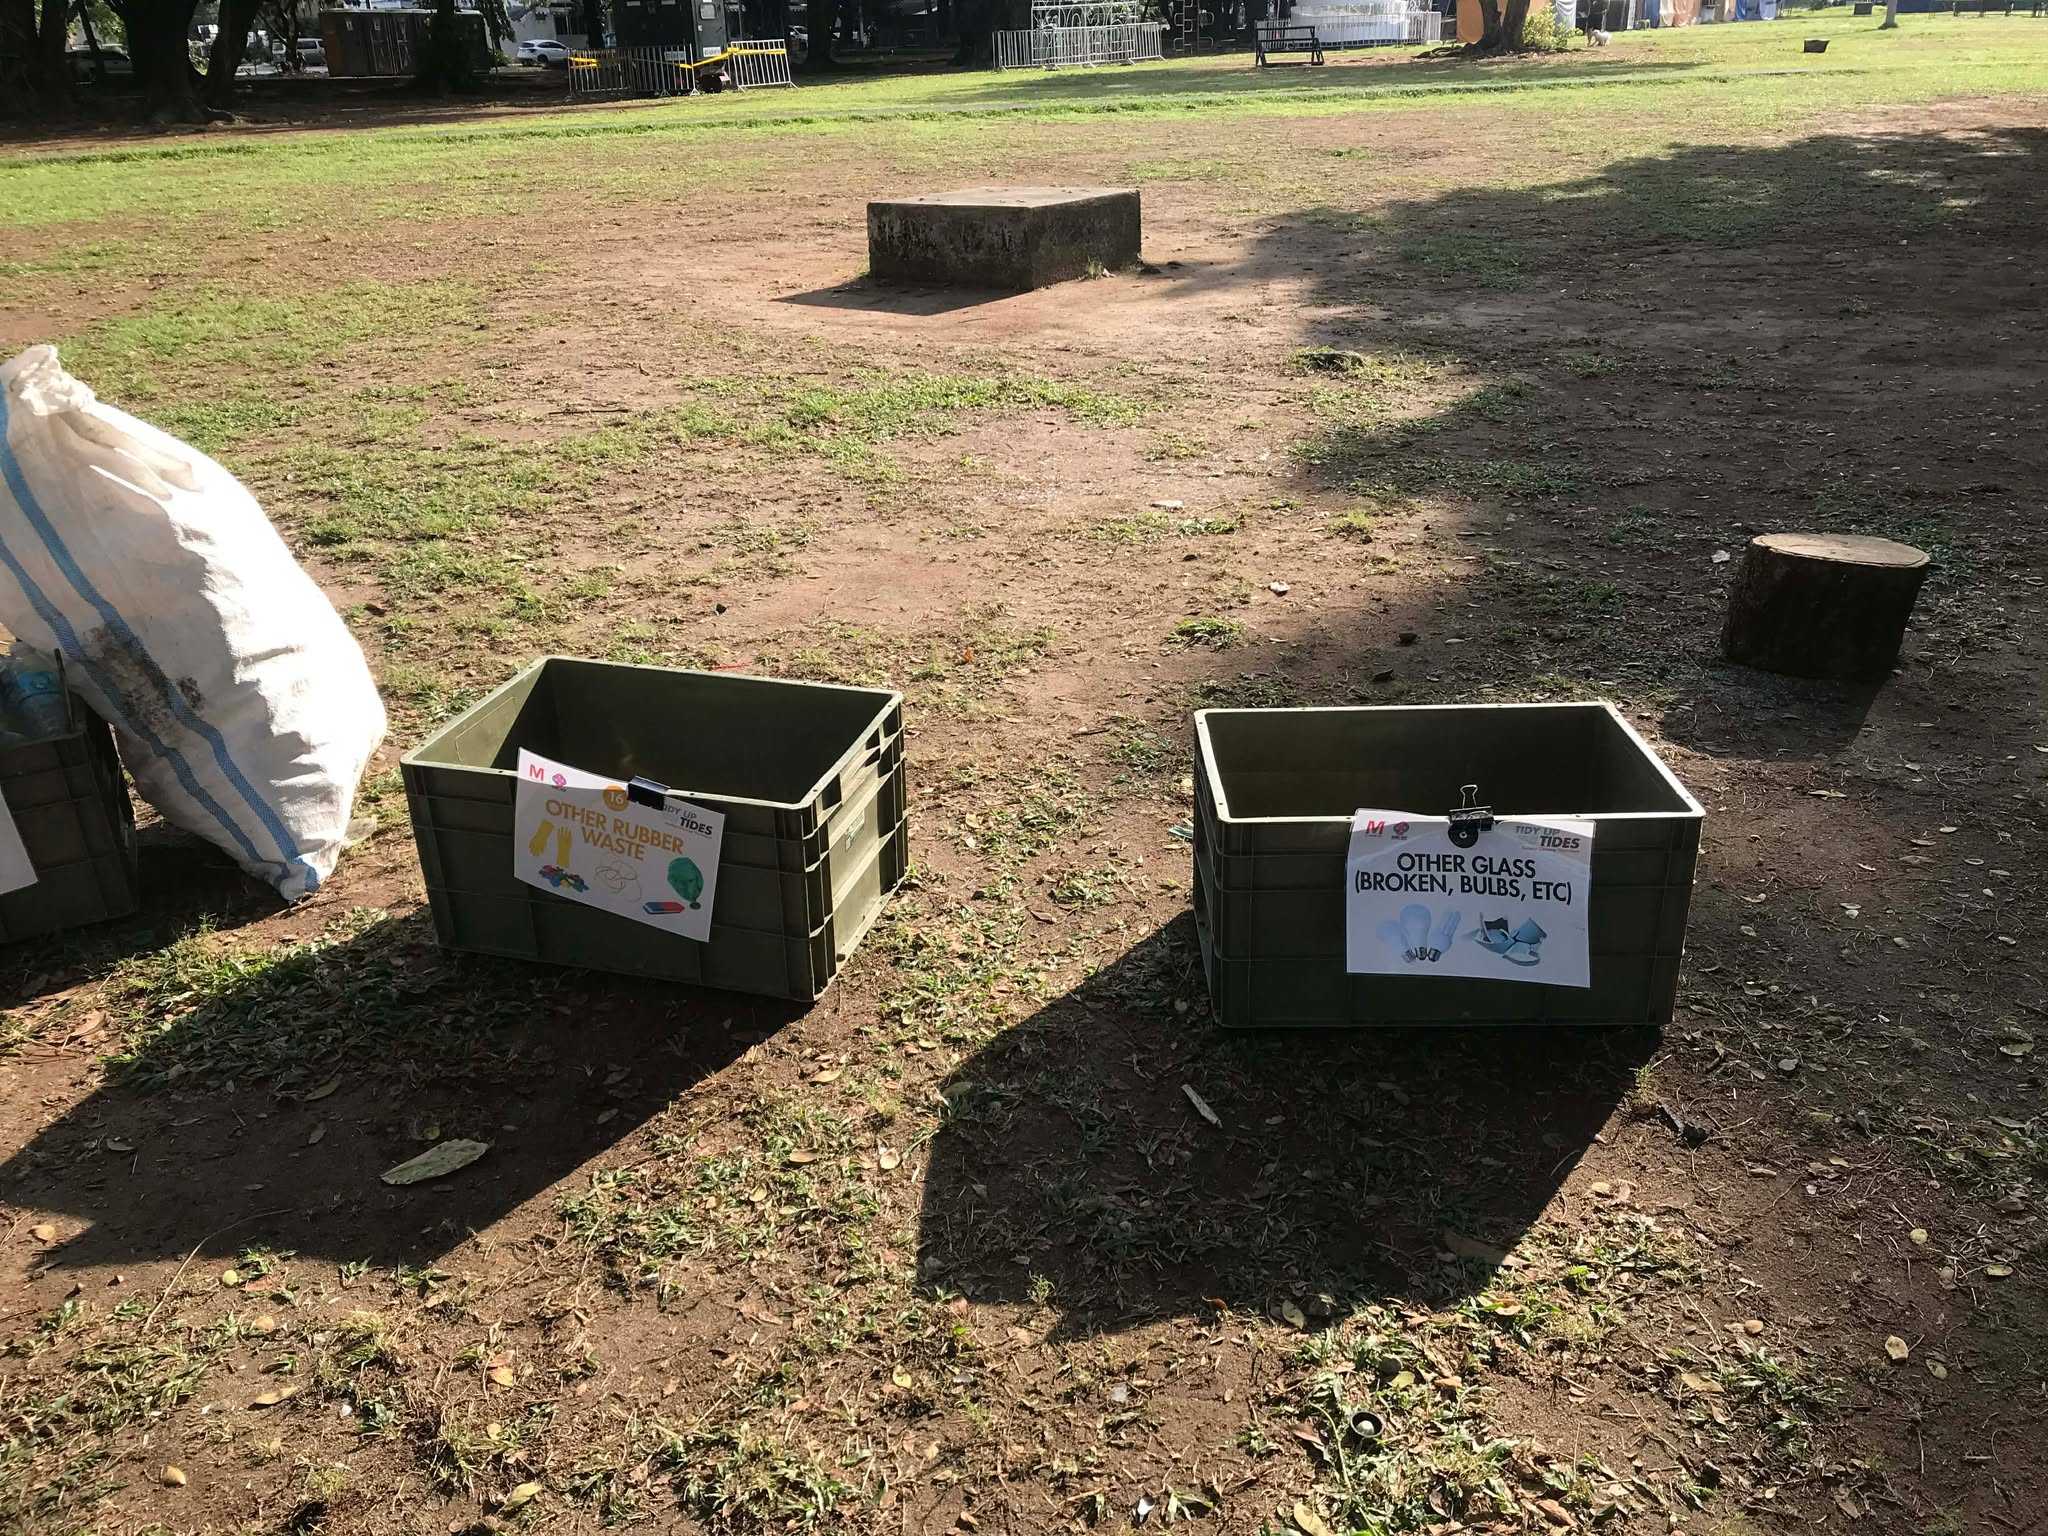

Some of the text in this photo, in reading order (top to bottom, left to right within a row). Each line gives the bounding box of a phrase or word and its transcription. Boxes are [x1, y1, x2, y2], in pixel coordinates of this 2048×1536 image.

[529, 764, 545, 781] M
[609, 791, 624, 804] 16
[664, 804, 697, 819] IDY UP
[545, 799, 684, 855] OTHER RUBBER
[680, 817, 713, 835] TIDES
[1365, 821, 1385, 834] M
[1515, 825, 1560, 836] TIDY UP
[580, 827, 646, 861] WASTE
[1540, 835, 1580, 849] TIDES
[1396, 852, 1536, 879] OTHER GLASS
[1354, 871, 1572, 905] (BROKEN, BULBS, ETC)
